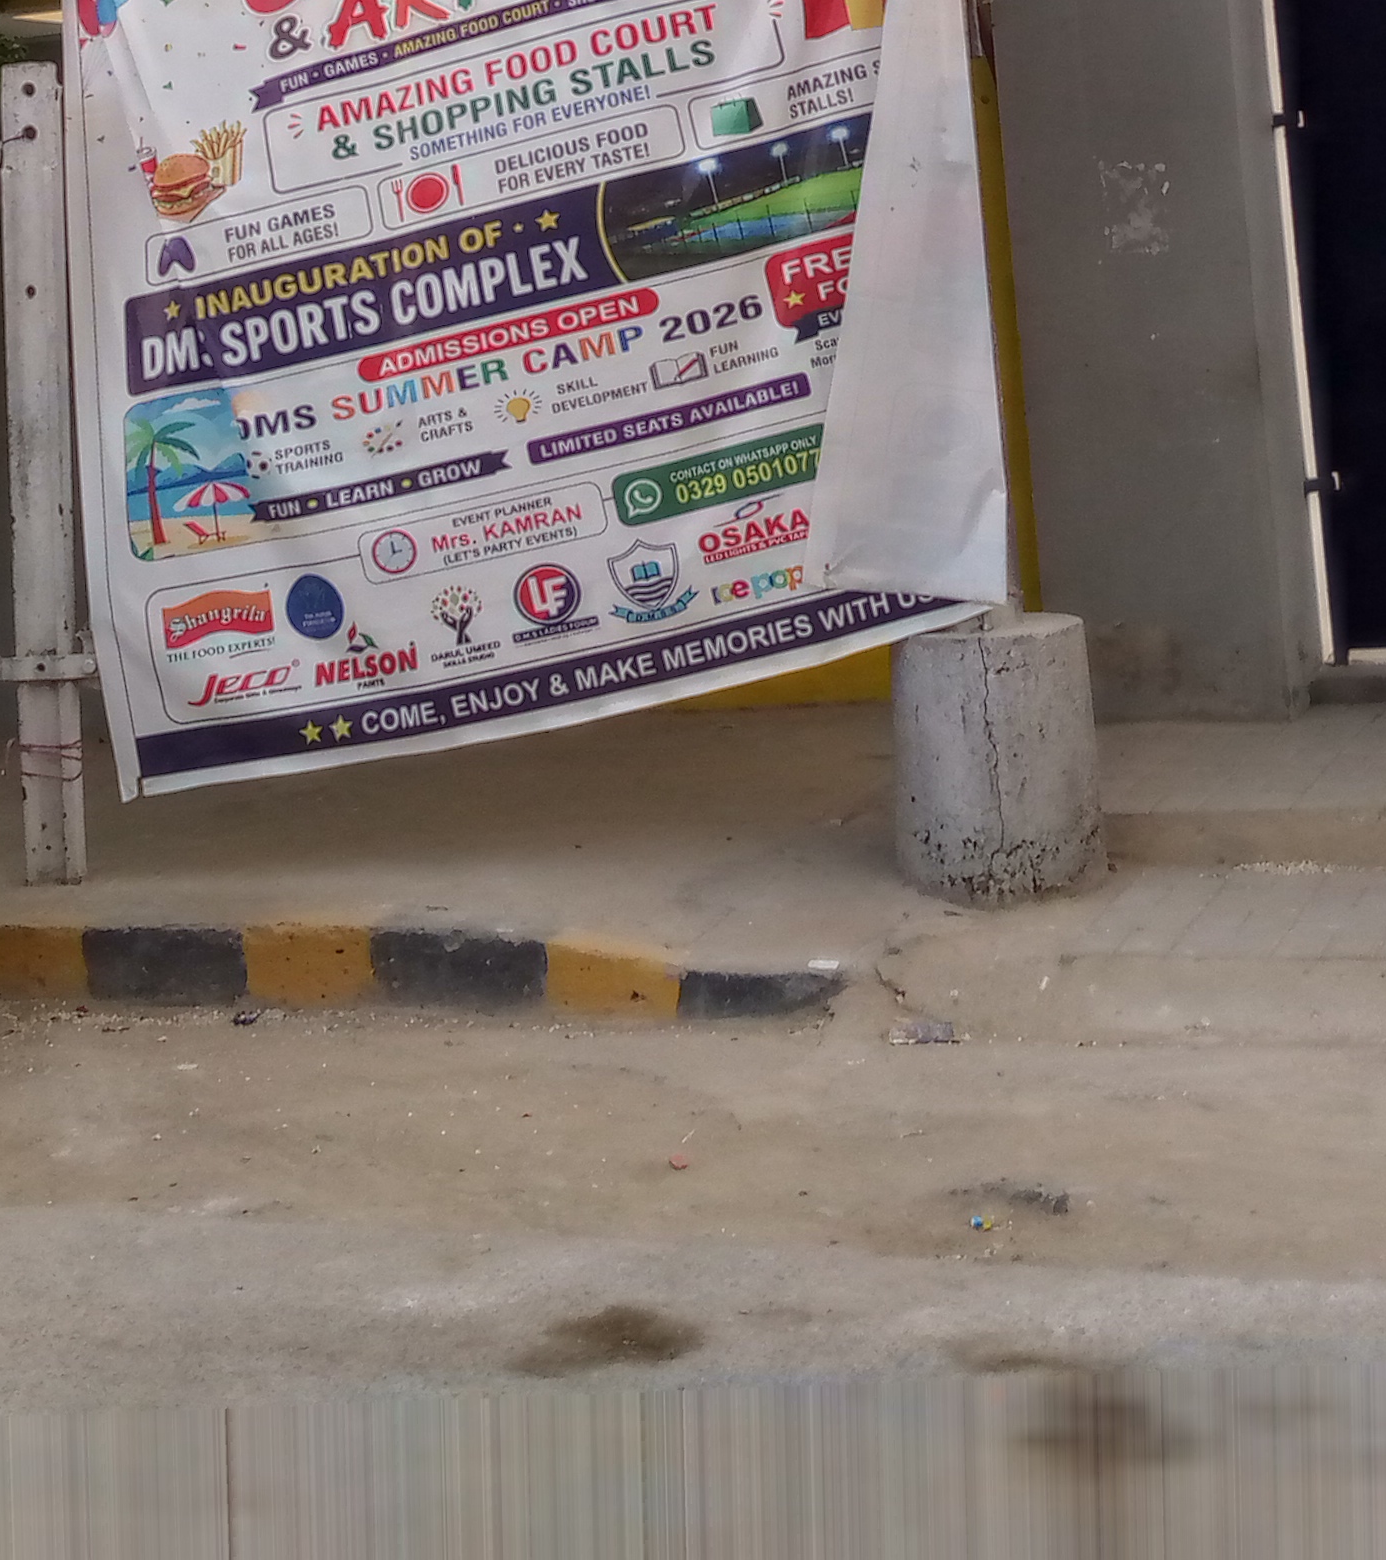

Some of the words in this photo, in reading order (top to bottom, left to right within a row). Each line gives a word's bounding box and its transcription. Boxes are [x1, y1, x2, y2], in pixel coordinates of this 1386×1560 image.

[269, 16, 312, 60] &
[279, 72, 309, 93] FUN
[323, 51, 379, 78] GAMES
[394, 30, 457, 58] AMAZING
[461, 17, 499, 39] FOOD
[503, 0, 551, 25] COURT
[317, 67, 475, 132] AMAZING
[484, 39, 578, 87] FOOD
[589, 3, 717, 57] COURT
[786, 64, 869, 101] AMAZING
[331, 133, 359, 160] &
[373, 77, 556, 151] SHOPPING
[569, 39, 716, 98] STALLS
[409, 122, 508, 161] SOMETHING
[513, 110, 547, 133] FOR
[552, 84, 652, 123] EVERYONE!
[789, 89, 854, 119] STALLS!
[494, 131, 591, 175] DELICIOUS
[596, 121, 649, 147] FOOD
[497, 169, 531, 193] FOR
[533, 158, 588, 185] EVERY
[591, 143, 650, 171] TASTE!
[224, 217, 264, 243] FUN
[267, 203, 336, 233] GAMES
[227, 240, 257, 263] FOR
[261, 232, 289, 256] ALL
[293, 223, 340, 250] AGES!
[194, 235, 451, 320] INAUGURATION
[458, 219, 503, 254] OF
[219, 288, 382, 369] SPORTS
[389, 235, 589, 327] COMPLEX
[331, 358, 508, 420] SUMMER
[522, 325, 644, 375] CAMP
[659, 295, 764, 344] 2026
[378, 317, 550, 378] ADMISSIONS
[557, 295, 639, 332] OPEN
[274, 440, 331, 460] SPORTS
[418, 409, 453, 428] ARTS
[556, 376, 598, 395] SKILL
[709, 340, 739, 358] FUN
[276, 451, 344, 474] TRAINING
[420, 420, 474, 442] CRAFTS
[551, 381, 648, 414] DEVELOPMENT
[713, 346, 779, 375] LEARNING
[540, 428, 619, 459] LIMITED
[623, 406, 683, 440] SEATS
[690, 381, 800, 422] AVAILABLE!
[669, 459, 717, 482] CONTACT
[719, 456, 732, 470] ON
[734, 440, 789, 467] WHATSAPP
[789, 435, 817, 453] ONLY
[675, 472, 727, 502] 0329
[732, 447, 821, 489] 0501077
[267, 499, 302, 520] FUN
[326, 480, 394, 510] LEARN
[418, 459, 482, 488] GROW
[452, 511, 491, 529] EVENT
[495, 495, 552, 517] PLANNER
[431, 531, 478, 553] Mrs.
[483, 504, 583, 540] KAMRAN
[443, 547, 479, 566] (LET'S
[483, 538, 523, 557] PARTY
[526, 525, 578, 547] EVENTS)
[698, 508, 810, 554] OSAKA
[725, 544, 757, 560] LIGHTS
[787, 530, 809, 542] TAP
[166, 650, 190, 663] THE
[192, 644, 225, 659] FOOD
[315, 645, 419, 687] NELSON
[362, 701, 449, 736] COME,
[452, 674, 541, 718] ENJOY
[548, 671, 570, 699] &
[575, 654, 657, 691] MAKE
[663, 614, 813, 672] MEMORIES
[817, 592, 892, 633] WITH
[357, 677, 385, 690] PAINTS
